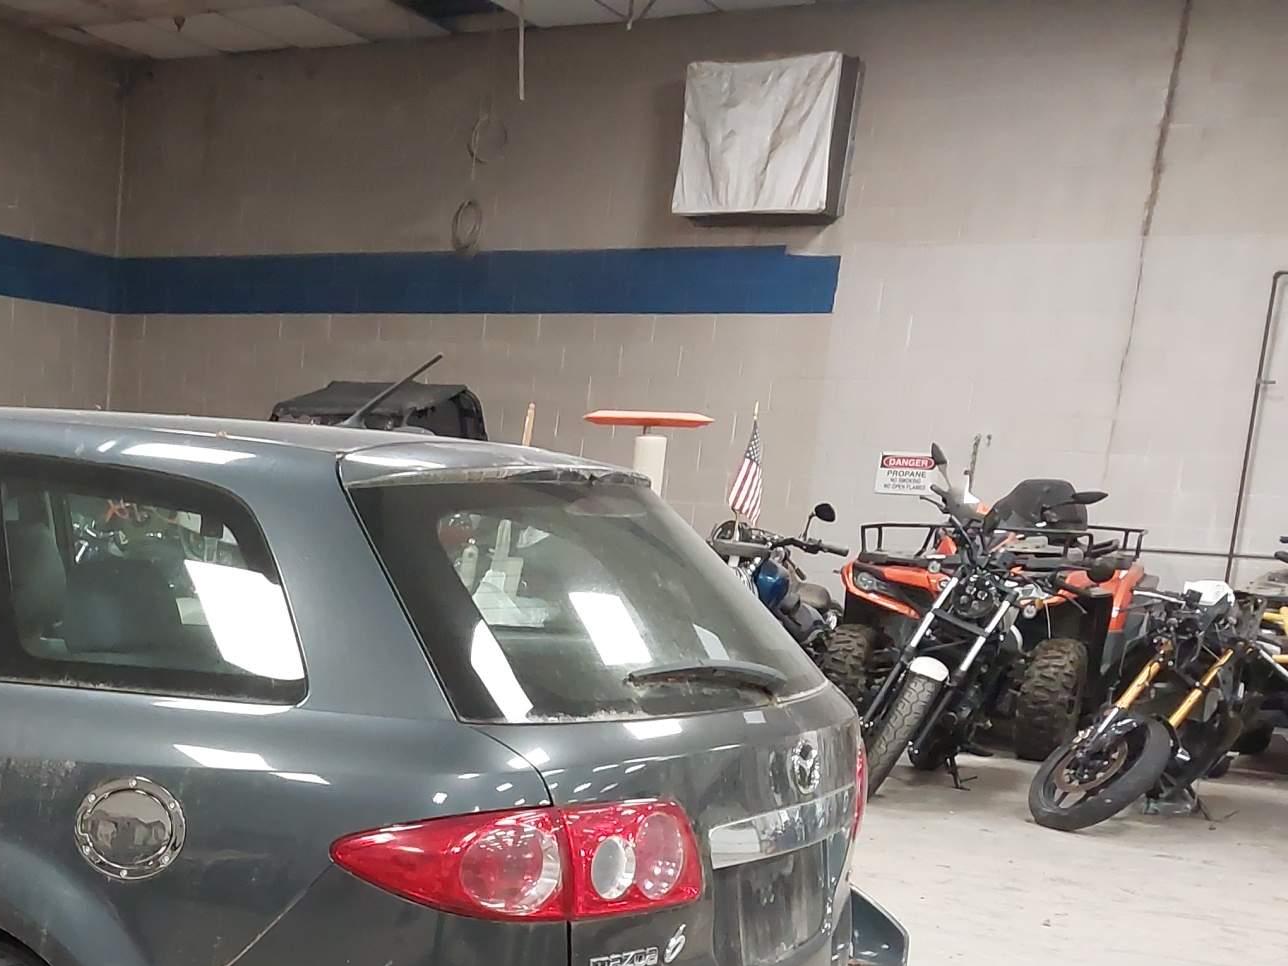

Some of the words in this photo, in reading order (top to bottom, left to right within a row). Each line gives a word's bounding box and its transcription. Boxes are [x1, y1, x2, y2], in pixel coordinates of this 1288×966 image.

[888, 458, 928, 467] DANGER
[887, 470, 926, 478] PROPANE
[663, 923, 687, 964] 6
